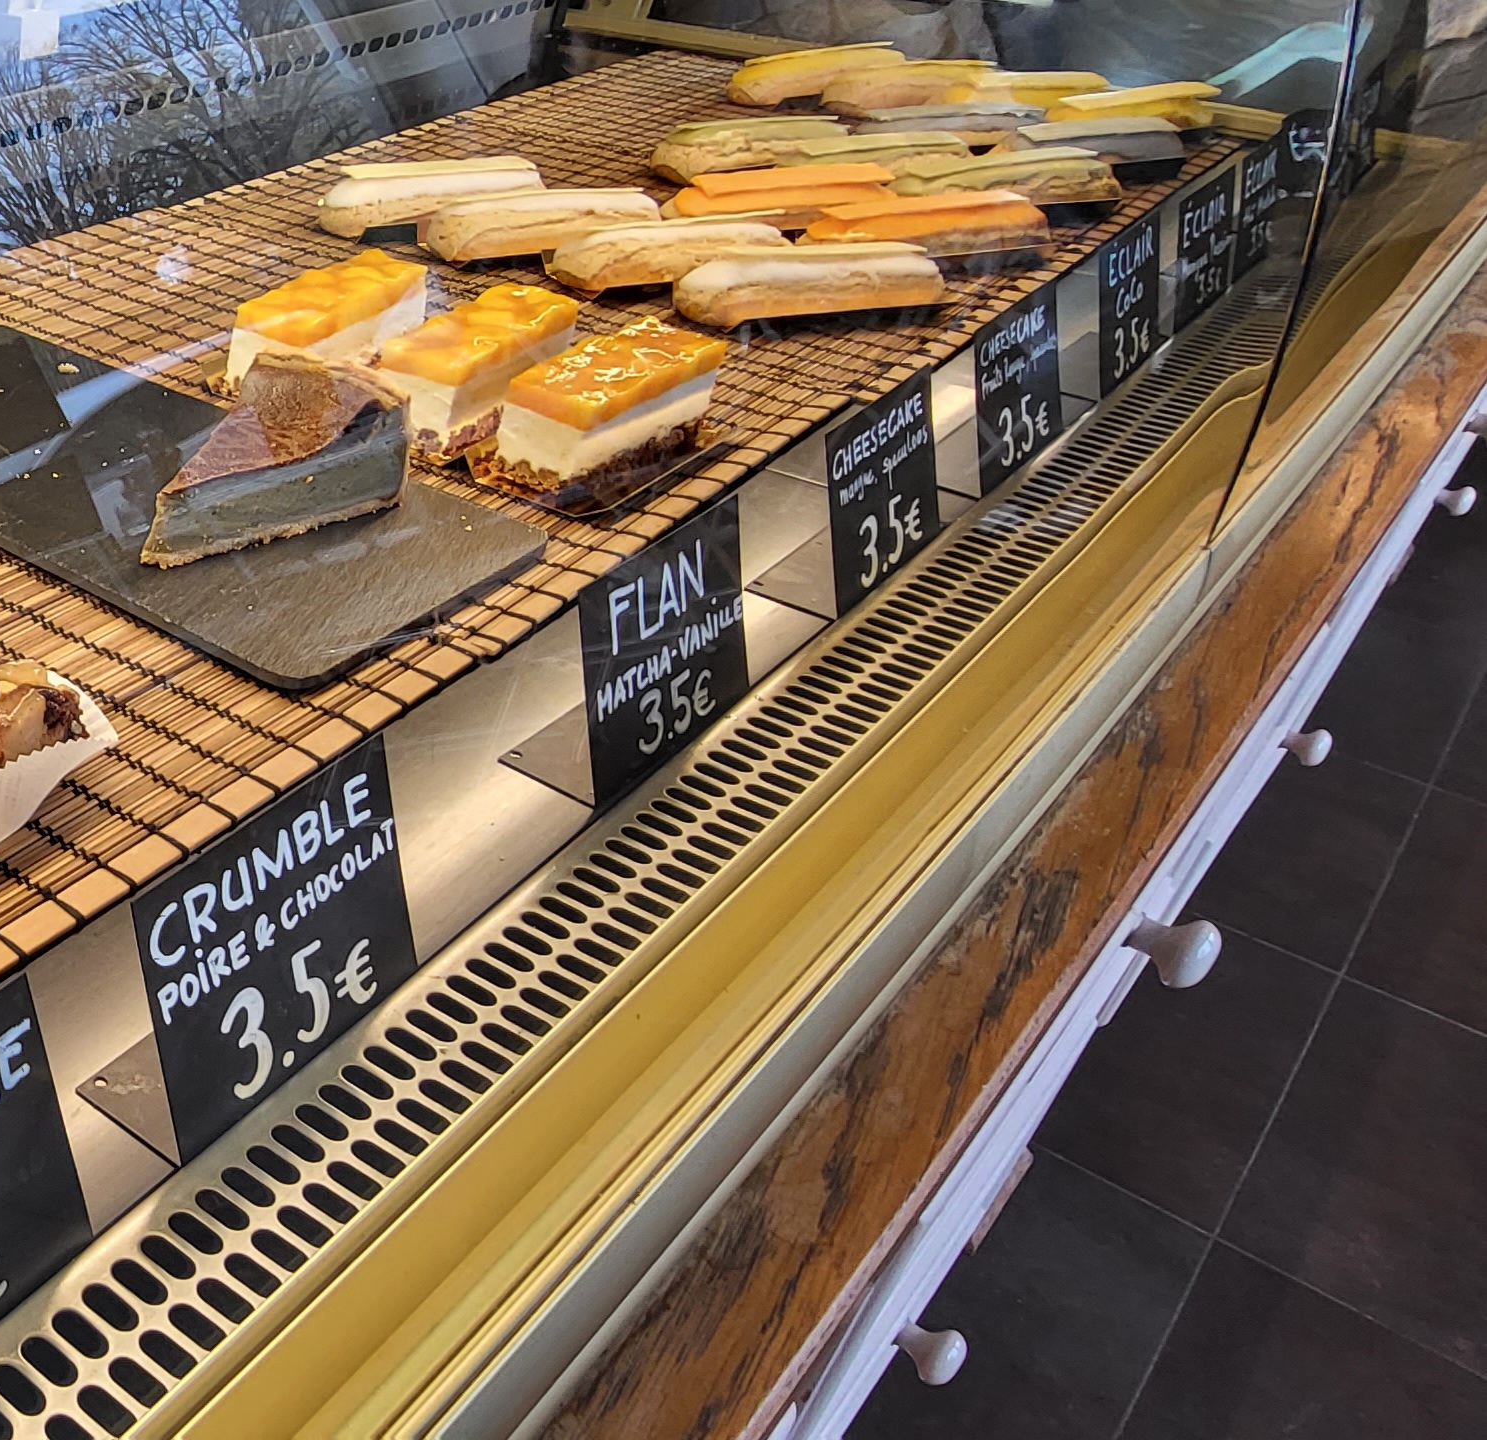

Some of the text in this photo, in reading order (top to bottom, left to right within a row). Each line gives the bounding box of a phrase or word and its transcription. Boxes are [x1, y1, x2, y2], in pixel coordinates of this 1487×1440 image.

[979, 304, 1045, 367] CHEESECAKE
[1114, 316, 1150, 379] 3.5€
[832, 392, 923, 481] CHEESECAKE
[998, 393, 1049, 467] 3.5€
[859, 494, 923, 588] 3.5€
[608, 538, 705, 656] FLAN
[638, 667, 716, 755] 3.5€
[149, 773, 373, 967] CRUMBLE
[254, 913, 277, 952] &
[280, 818, 395, 931] CHOCOLAT
[220, 938, 378, 1100] 3.5€
